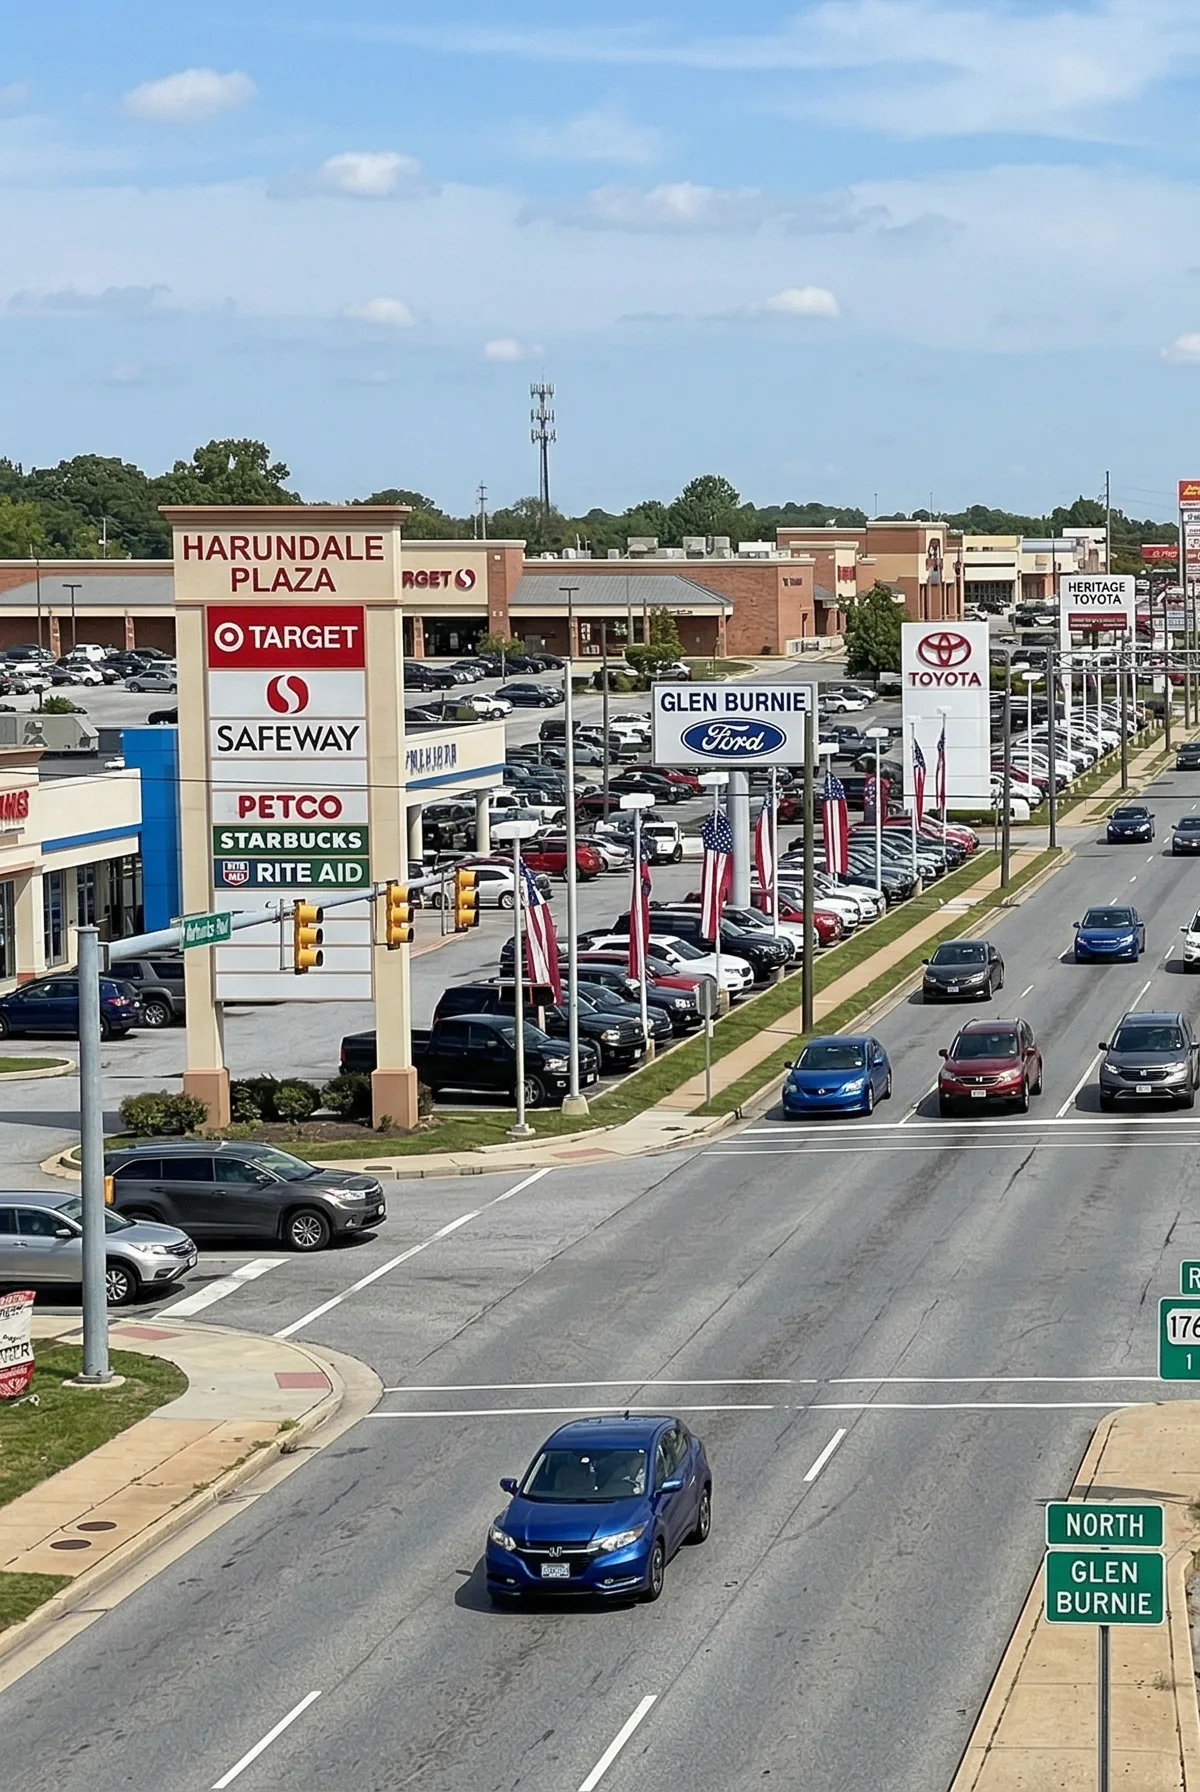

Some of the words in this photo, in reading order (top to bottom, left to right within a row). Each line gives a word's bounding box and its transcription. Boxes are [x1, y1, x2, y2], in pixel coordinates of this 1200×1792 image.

[183, 535, 384, 561] HARUNDALE
[231, 567, 336, 592] PLAZA
[402, 571, 452, 588] RGET
[1068, 582, 1126, 592] HERITAGE
[1073, 594, 1122, 605] TOYOTA
[249, 626, 358, 648] TARGET
[908, 672, 982, 687] TOYOTA
[660, 692, 717, 712] GLEN
[725, 692, 806, 712] BURNIE
[218, 725, 360, 751] SAFEWAY
[702, 723, 765, 750] Ford
[238, 795, 342, 819] PETCO
[221, 832, 362, 849] STARBUCKS
[257, 863, 312, 882] RITE
[318, 863, 363, 882] AID
[1186, 1353, 1192, 1370] 1
[1066, 1513, 1143, 1537] NORTH
[1071, 1560, 1138, 1583] GLEN
[1057, 1591, 1152, 1615] BURNIE
